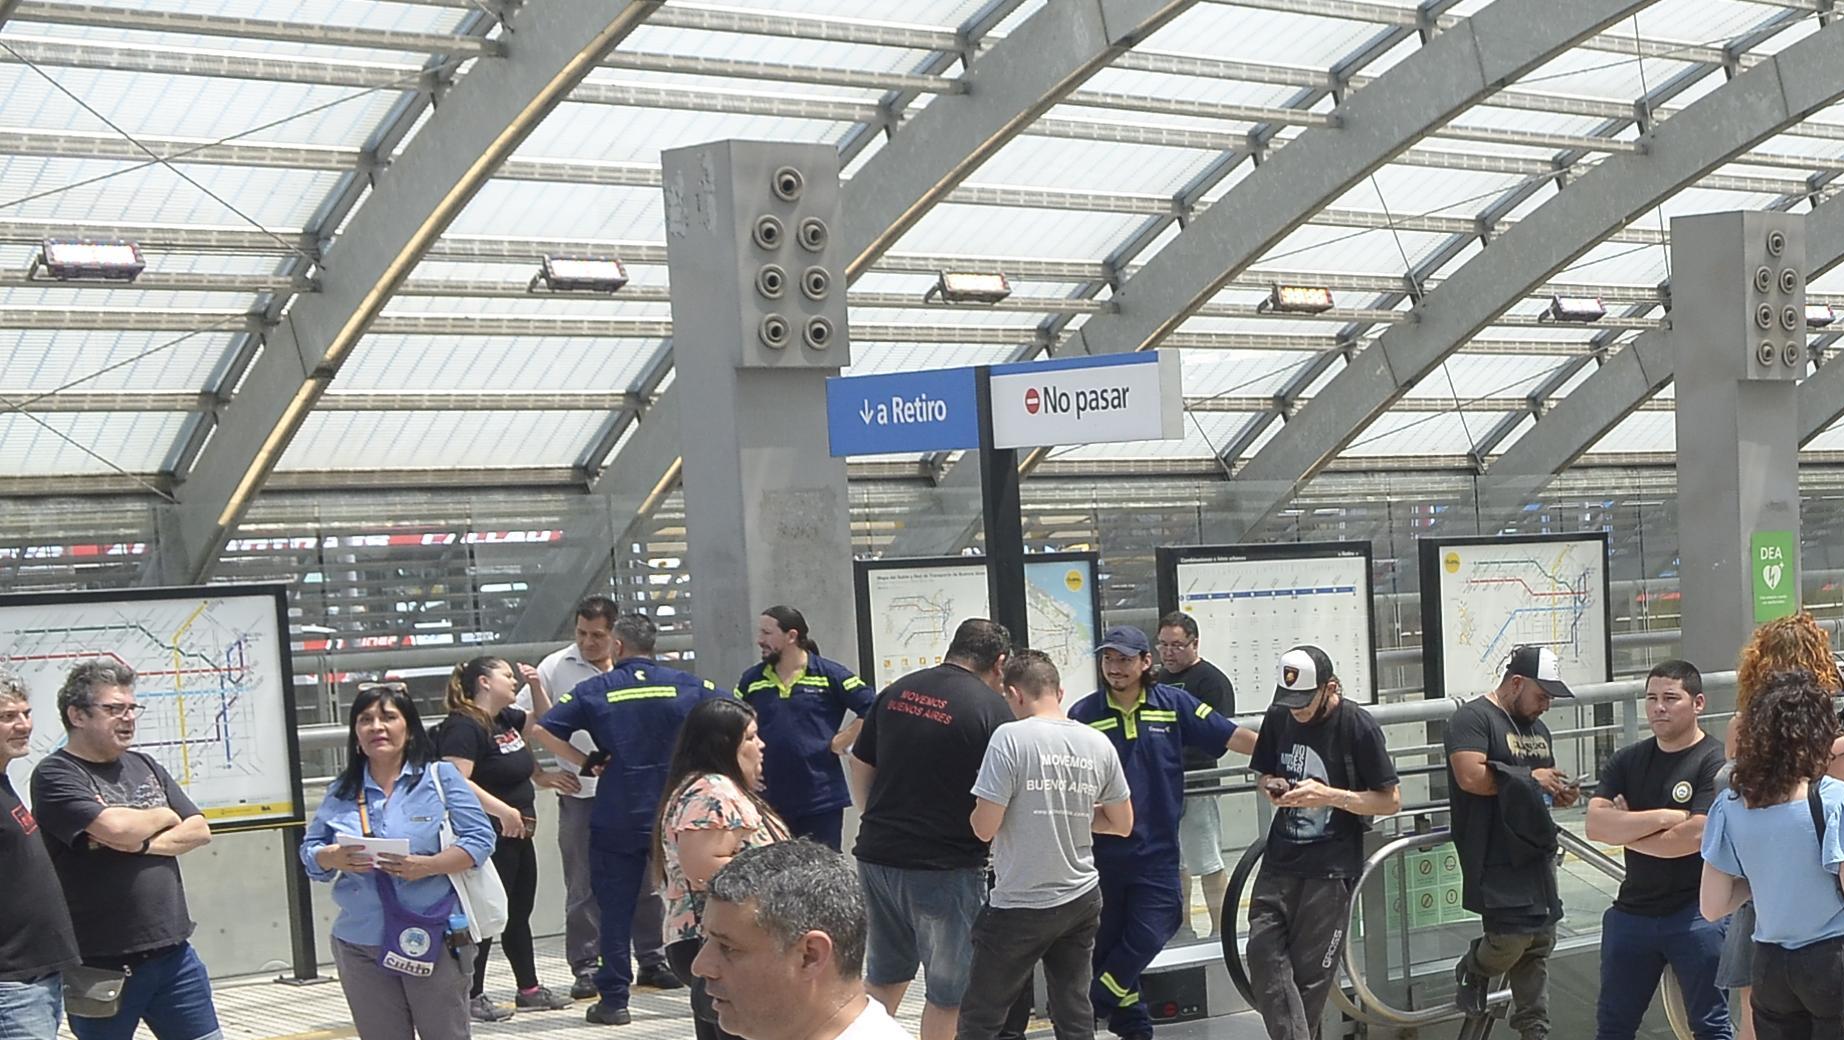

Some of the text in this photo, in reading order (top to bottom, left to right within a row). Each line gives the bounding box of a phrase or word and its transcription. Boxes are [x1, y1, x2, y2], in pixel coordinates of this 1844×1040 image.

[876, 393, 948, 425] a Retiro
[1043, 385, 1130, 419] No pasar
[1760, 546, 1783, 560] DEA
[901, 689, 948, 709] MOVEMOS
[887, 700, 953, 725] BUENOS AIRES
[1041, 753, 1094, 771] MOVEMOS
